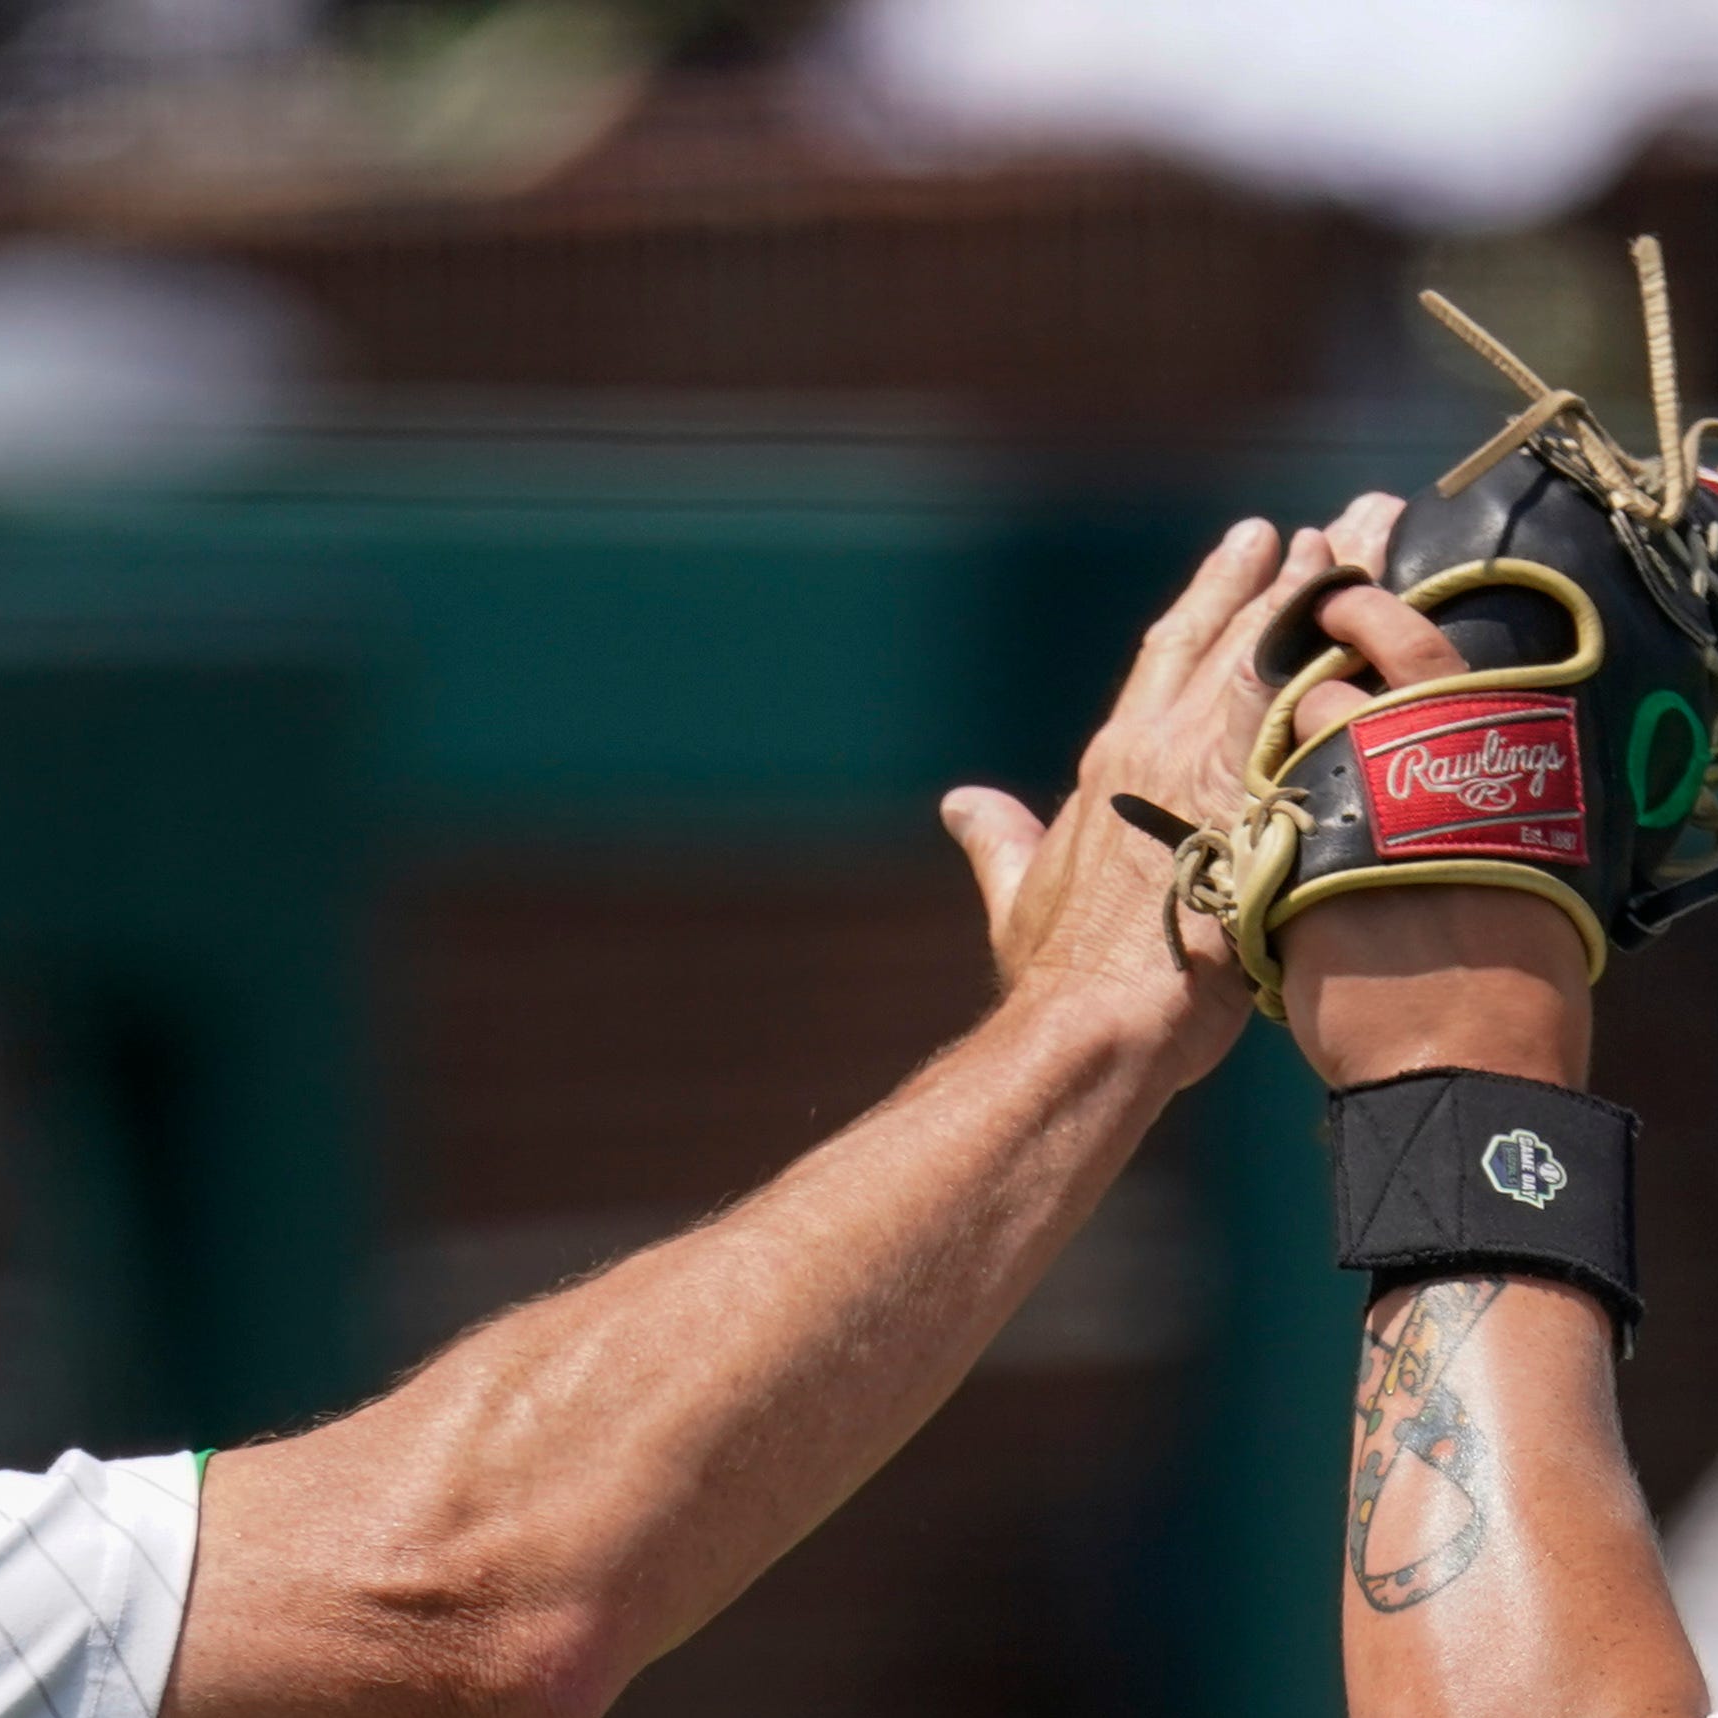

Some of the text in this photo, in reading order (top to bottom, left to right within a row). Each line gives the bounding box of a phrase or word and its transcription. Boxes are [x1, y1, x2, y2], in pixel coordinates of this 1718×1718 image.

[1386, 728, 1568, 801] Rawlings
[1519, 1136, 1537, 1199] GAME DAY
